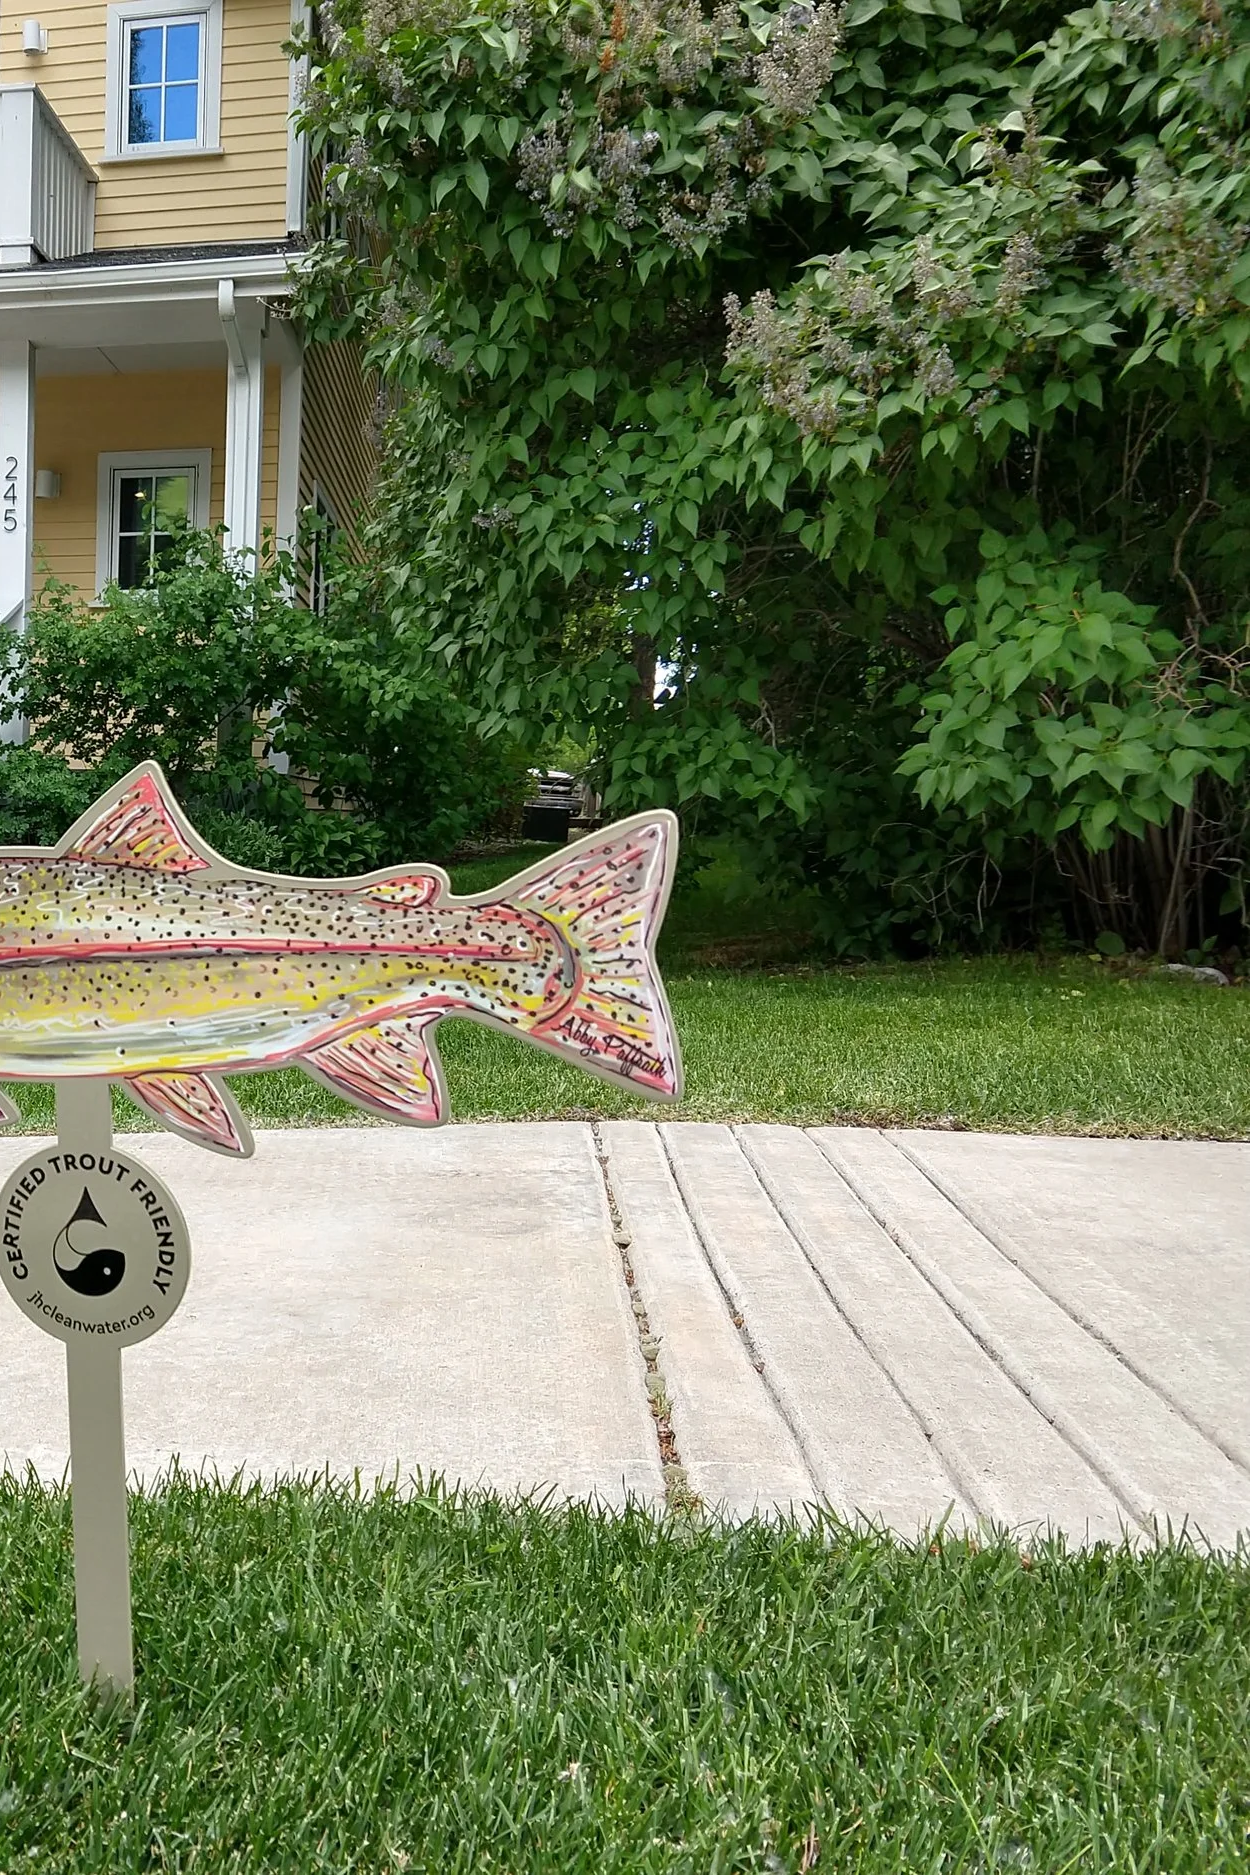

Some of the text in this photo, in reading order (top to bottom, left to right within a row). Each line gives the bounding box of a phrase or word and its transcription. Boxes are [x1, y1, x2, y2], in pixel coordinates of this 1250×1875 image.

[3, 456, 18, 532] 245
[551, 1015, 601, 1057] Abby
[2, 1153, 175, 1296] CERTIFIED TROUT FRIENDLY
[26, 1290, 155, 1334] jhcleanwater.org
